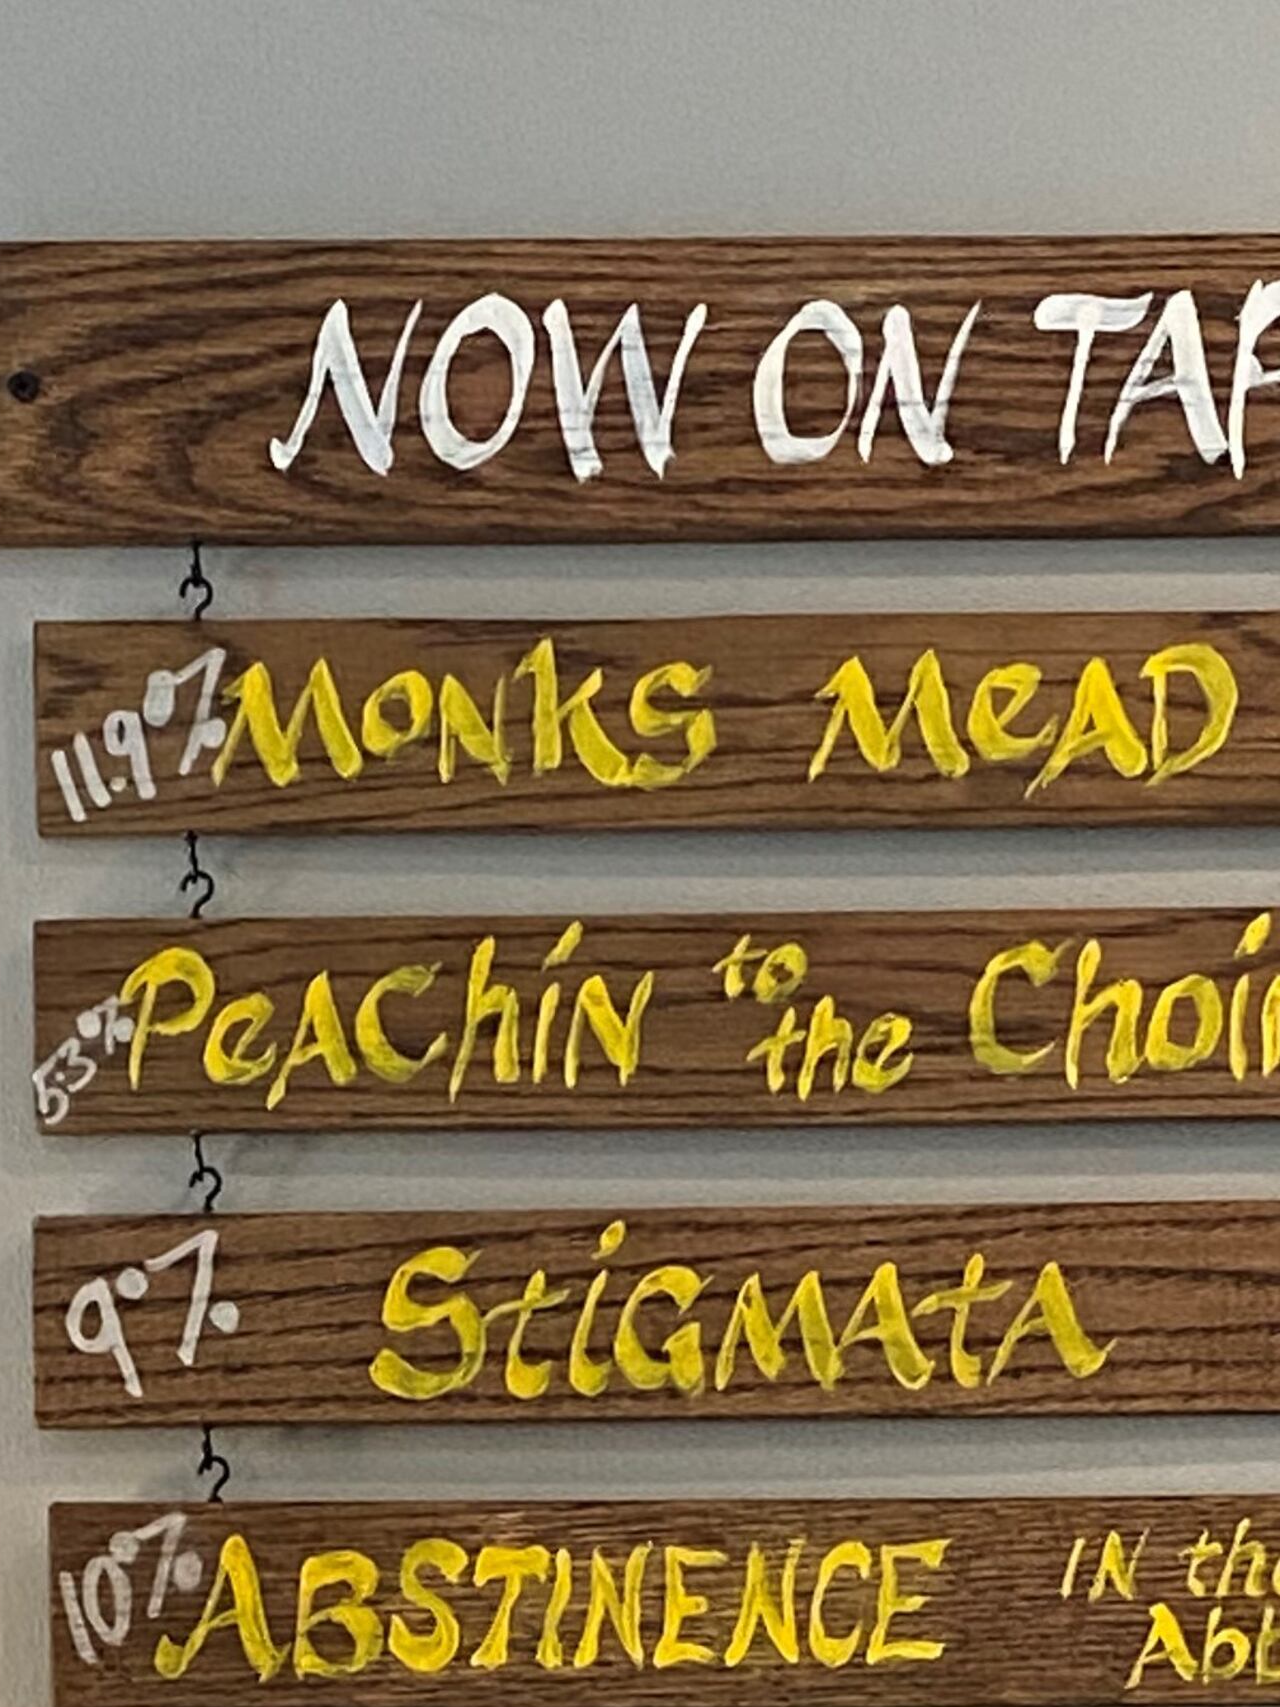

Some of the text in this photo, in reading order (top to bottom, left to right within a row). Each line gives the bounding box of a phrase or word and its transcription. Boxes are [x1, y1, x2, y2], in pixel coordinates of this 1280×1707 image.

[270, 291, 712, 483] NOW
[753, 298, 982, 466] ON
[50, 647, 228, 823] 11.9%
[713, 934, 809, 1004] to
[746, 994, 914, 1102] the
[32, 995, 135, 1126] 5.3%
[64, 1229, 241, 1398] 9%
[59, 1513, 204, 1664] 10%
[154, 1532, 953, 1683] ABSTINENCE
